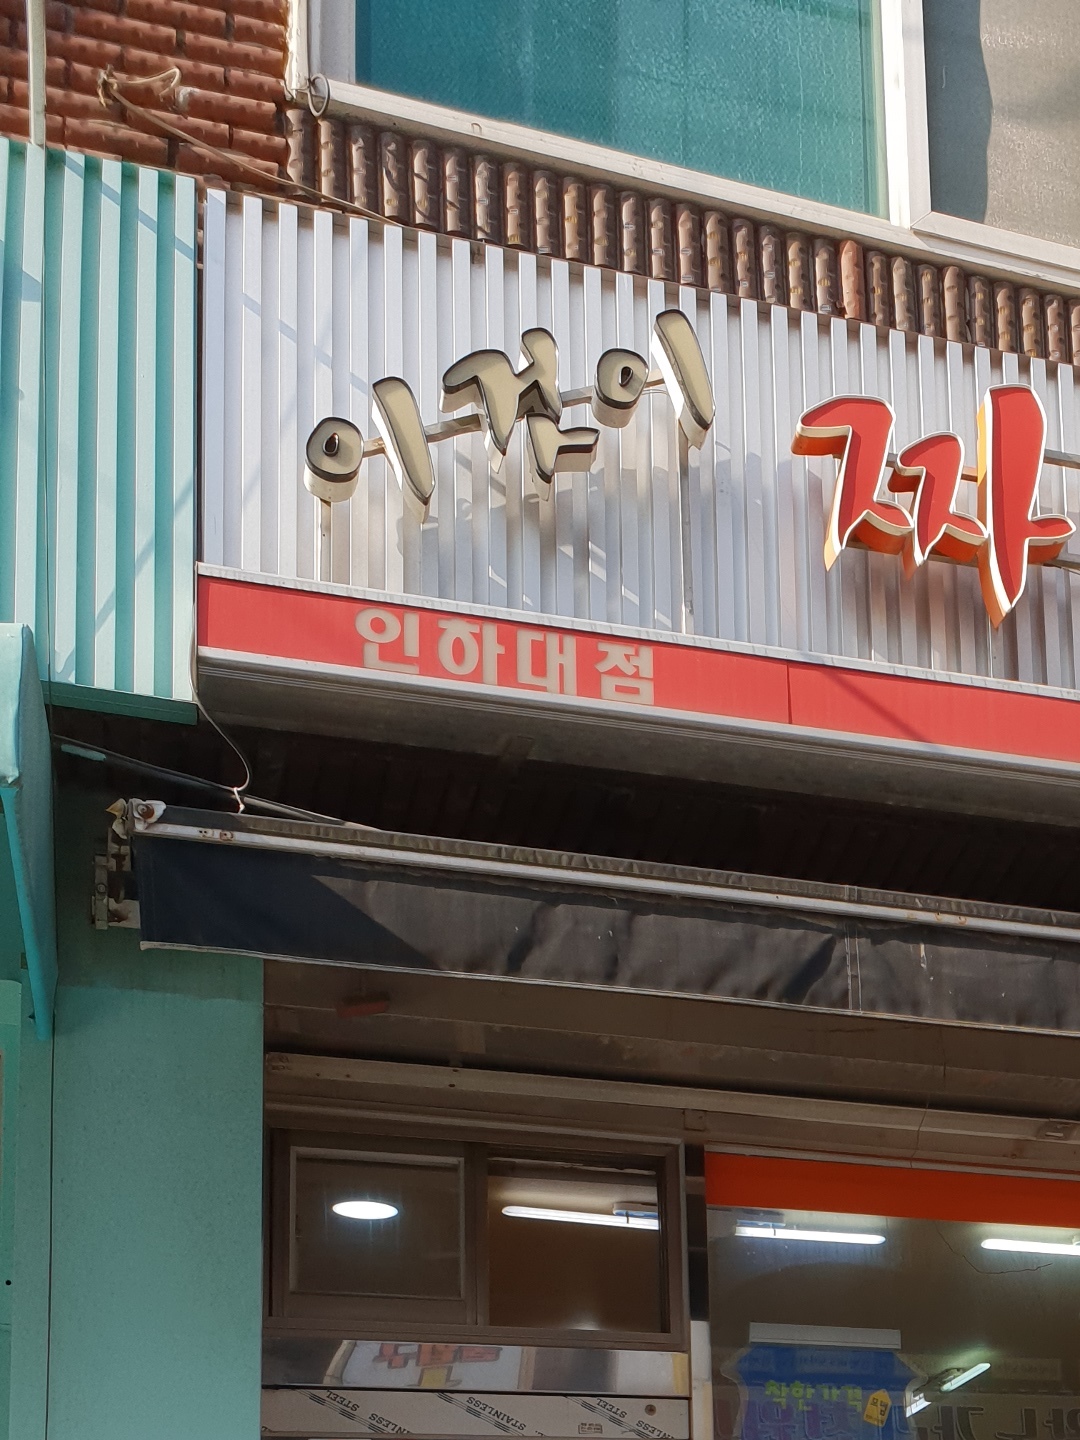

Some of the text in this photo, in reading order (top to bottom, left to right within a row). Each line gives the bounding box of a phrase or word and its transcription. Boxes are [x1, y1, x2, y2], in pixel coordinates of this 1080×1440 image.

[306, 309, 716, 506] 이것이
[354, 607, 656, 706] 인하대점
[466, 1396, 527, 1431] STAINLESS
